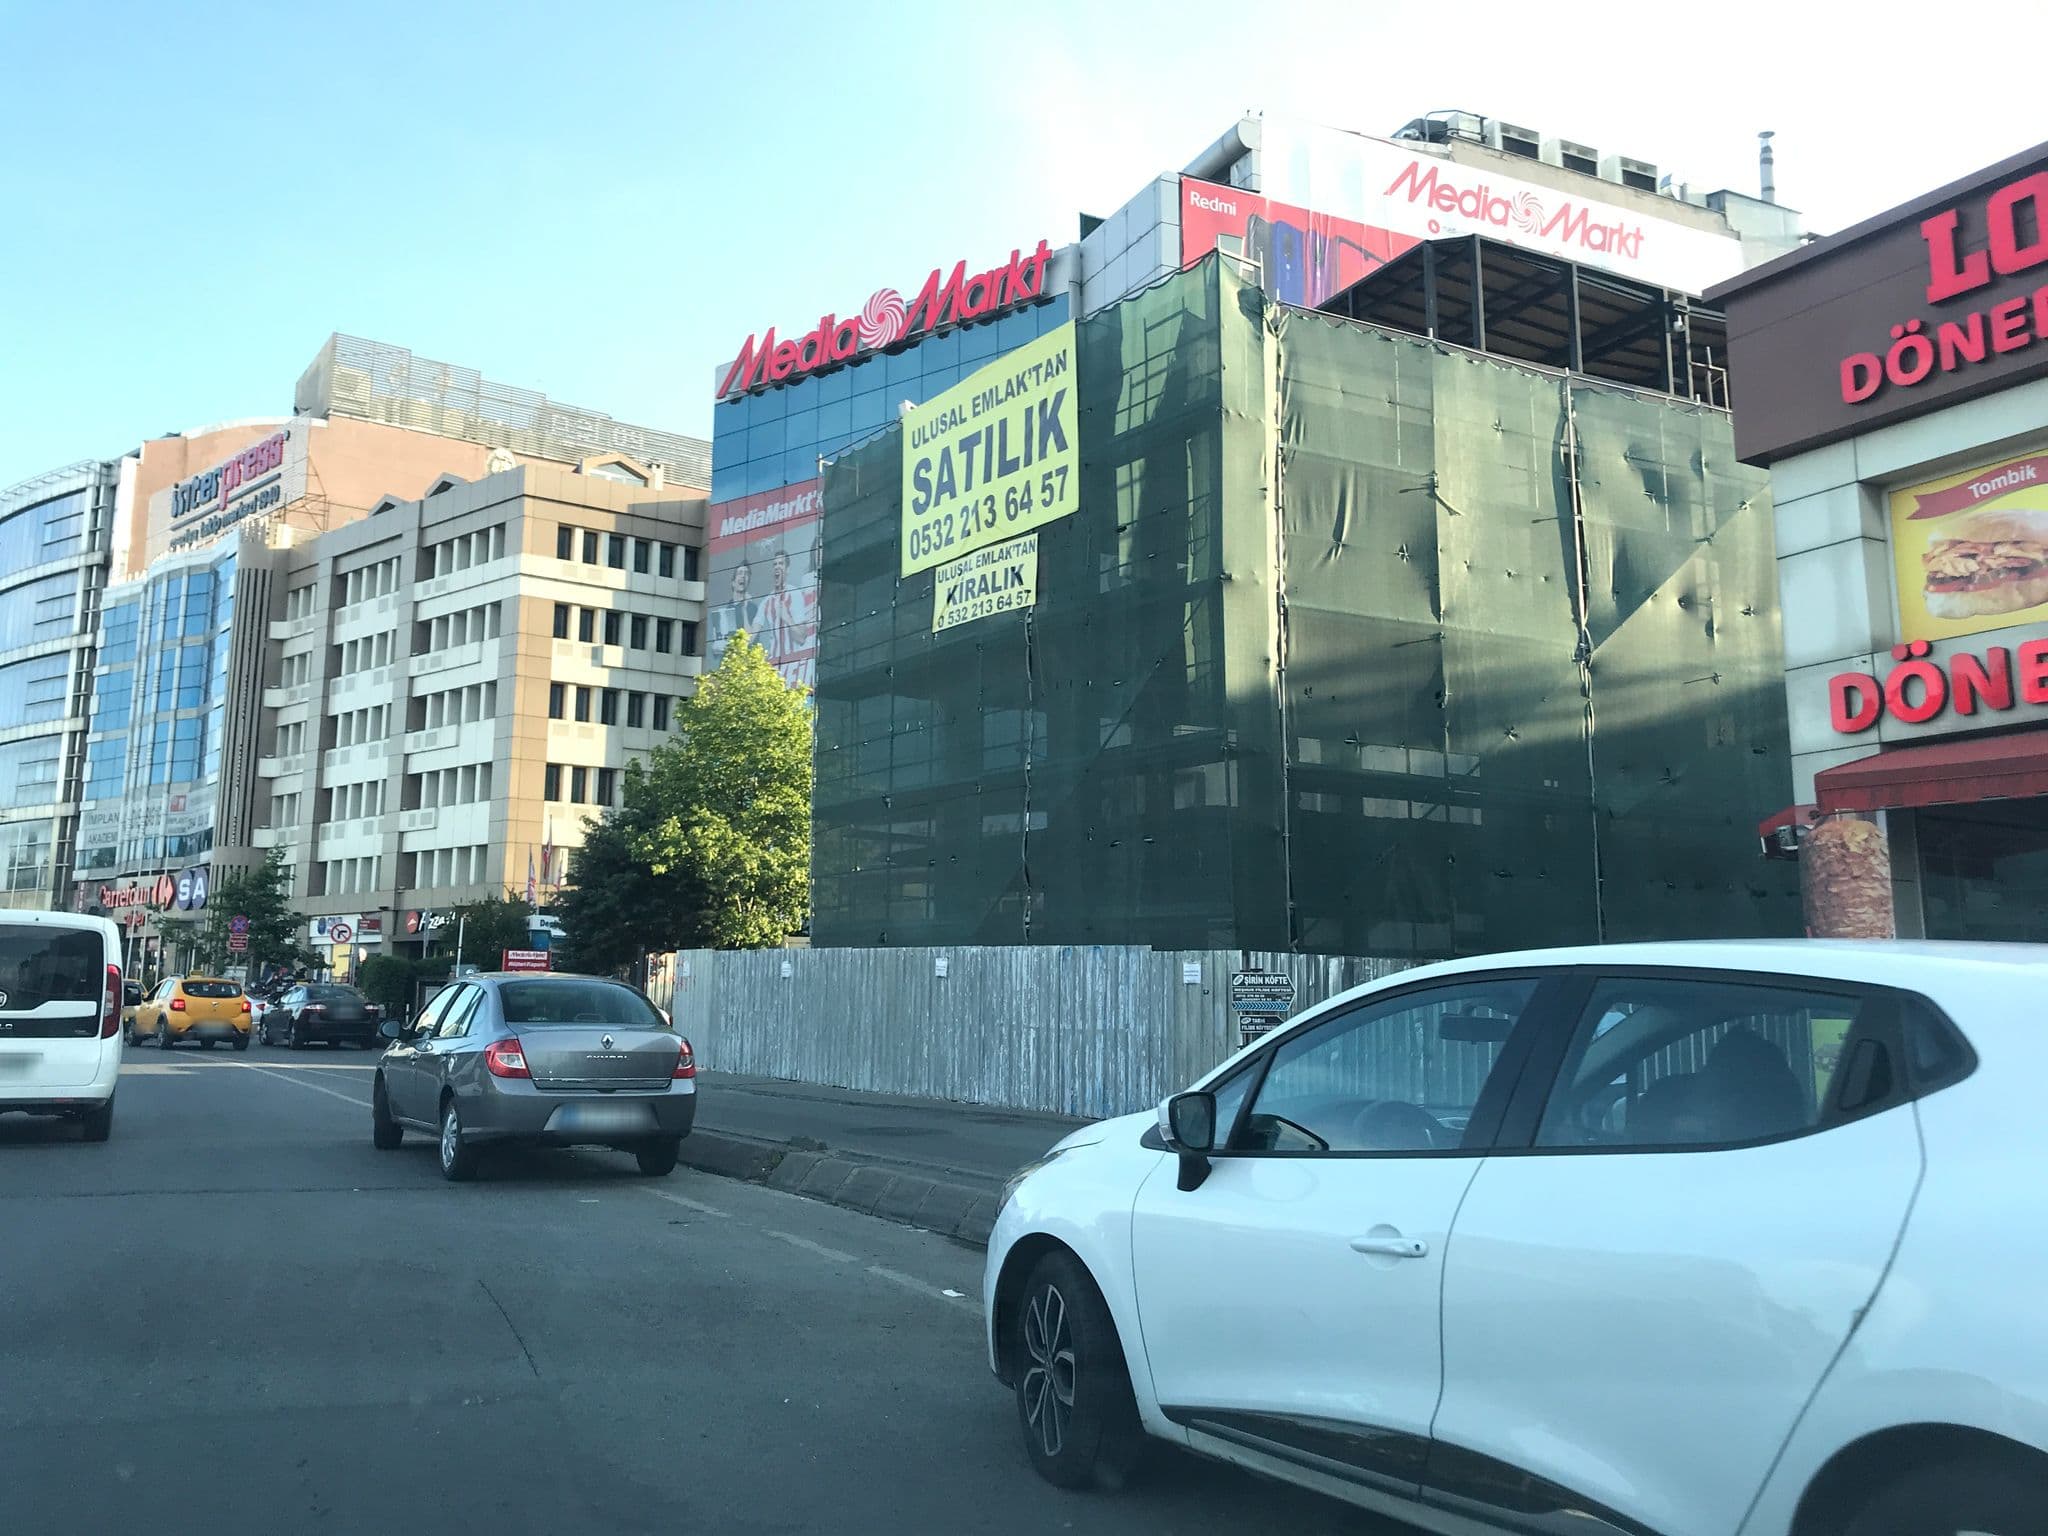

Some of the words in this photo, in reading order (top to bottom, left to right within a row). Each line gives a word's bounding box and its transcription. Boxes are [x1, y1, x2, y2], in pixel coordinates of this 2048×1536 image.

[1190, 191, 1237, 217] Redmi
[1384, 160, 1515, 227] Media
[1539, 202, 1645, 260] Markt
[715, 313, 863, 400] Media
[899, 239, 1054, 340] Markt
[912, 404, 968, 450] ULUSAL
[972, 348, 1068, 418] EMLAK'TAN
[911, 387, 1069, 516] SATILIK
[171, 433, 284, 518] interpress
[1967, 464, 2037, 499] Tombik
[909, 513, 955, 561] 0532
[960, 494, 998, 540] 213
[1004, 479, 1033, 522] 64
[1041, 464, 1069, 509] 57
[937, 561, 973, 584] ULUSAL
[975, 538, 1037, 569] EMLAK'TAN
[946, 563, 1025, 606] KİRALIK
[937, 615, 945, 628] 0
[947, 606, 968, 625] 532
[971, 598, 993, 618] 213
[996, 593, 1013, 611] 64
[1016, 589, 1032, 606] 57
[418, 911, 446, 931] Pzza
[1264, 974, 1289, 985] KÖFTE
